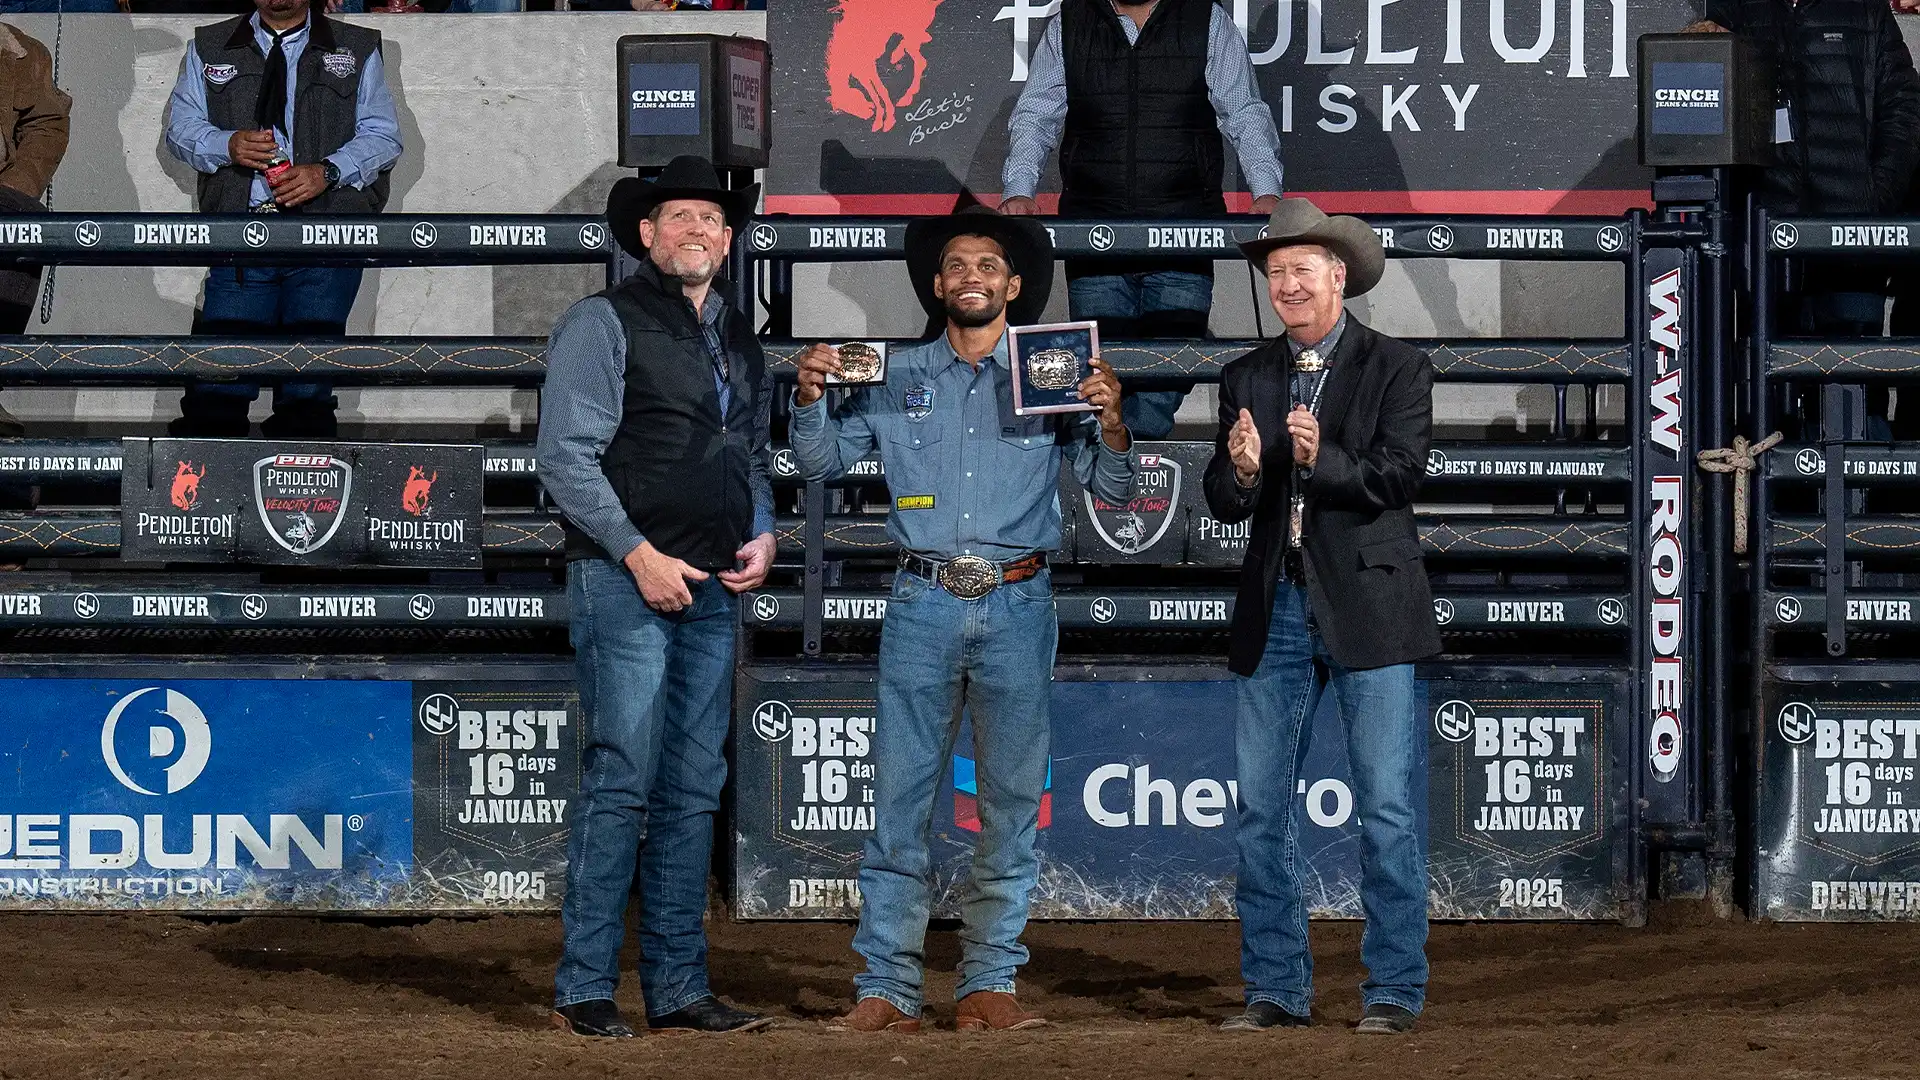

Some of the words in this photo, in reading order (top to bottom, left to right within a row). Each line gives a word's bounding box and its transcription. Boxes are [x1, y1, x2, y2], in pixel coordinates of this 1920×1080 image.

[632, 90, 696, 102] CINCH
[1655, 89, 1719, 101] CINCH
[134, 225, 210, 245] DENVER
[302, 225, 378, 245] DENVER
[470, 226, 546, 246] DENVER
[809, 228, 886, 248] DENVER
[1148, 228, 1225, 248] DENVER
[1487, 229, 1564, 249] DENVER
[1831, 226, 1908, 247] DENVER
[1650, 268, 1682, 460] W-W
[28, 457, 40, 470] 16
[43, 457, 74, 470] DAYS
[77, 457, 91, 470] IN
[277, 455, 328, 465] PBR
[511, 458, 525, 472] IN
[1445, 460, 1477, 475] BEST
[1480, 461, 1492, 475] 16
[1495, 461, 1527, 475] DAYS
[1529, 461, 1543, 475] IN
[1546, 462, 1605, 476] JANUARY
[1853, 461, 1865, 475] 16
[1869, 461, 1900, 475] DAYS
[1903, 461, 1917, 475] IN
[266, 468, 338, 488] PENDLETON
[279, 487, 327, 495] WHISKY
[136, 512, 232, 537] PENDLETON
[368, 517, 464, 543] PENDLETON
[158, 535, 210, 545] WHISKY
[389, 541, 441, 550] WHISKY
[132, 597, 209, 617] DENVER
[300, 597, 376, 617] DENVER
[467, 597, 544, 618] DENVER
[1149, 601, 1226, 621] DENVER
[1487, 602, 1564, 622] DENVER
[1650, 475, 1683, 784] RODEO
[458, 710, 567, 750] BEST
[1474, 717, 1584, 757] BEST
[1815, 719, 1920, 759] BEST
[469, 752, 514, 796] 16
[517, 754, 556, 774] days
[802, 760, 848, 803] 16
[1485, 760, 1530, 803] 16
[1534, 761, 1573, 781] days
[1826, 762, 1871, 805] 16
[1875, 763, 1914, 783] days
[529, 778, 545, 796] in
[1546, 786, 1564, 803] in
[1887, 788, 1902, 805] in
[458, 799, 567, 824] JANUARY
[1474, 806, 1584, 831] JANUARY
[1814, 808, 1920, 833] JANUARY
[483, 871, 546, 900] 2025
[1500, 878, 1563, 908] 2025
[1812, 881, 1920, 911] DENVER
